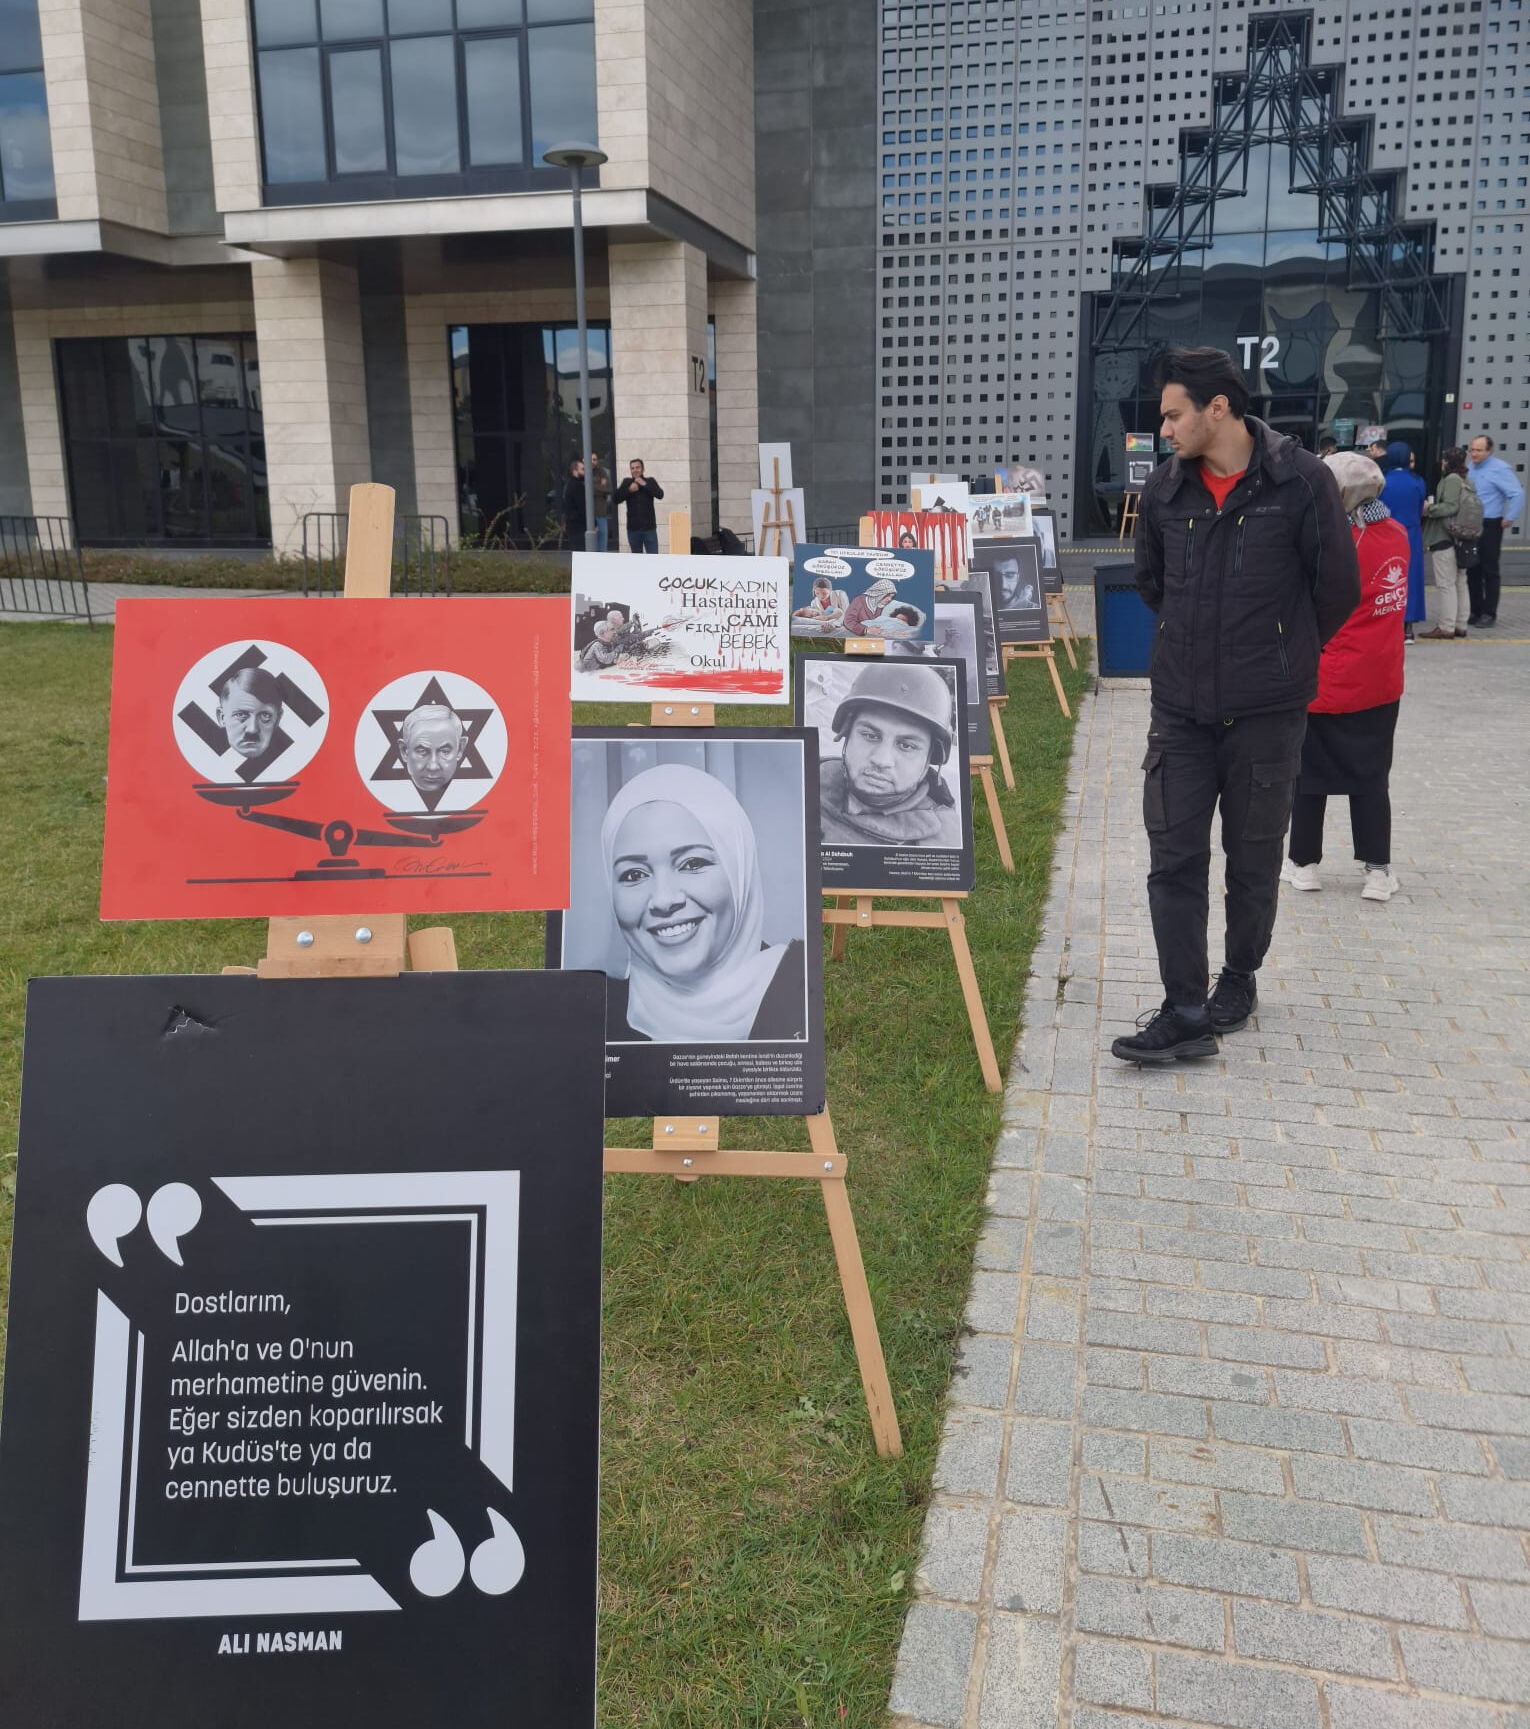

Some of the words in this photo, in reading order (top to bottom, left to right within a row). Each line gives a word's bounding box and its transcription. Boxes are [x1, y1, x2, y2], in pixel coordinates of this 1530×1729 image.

[1236, 335, 1280, 370] T2
[691, 355, 706, 394] T2
[659, 577, 718, 591] ÇOCUK
[720, 580, 778, 593] KADIN
[681, 592, 778, 609] Hastahane
[686, 623, 730, 634] FIRIN
[727, 612, 779, 628] CAMİ
[720, 633, 779, 650] BEBEK
[690, 654, 726, 668] Okul
[175, 1290, 291, 1315] Dostlarım,
[171, 1338, 249, 1362] Allah'a
[256, 1342, 283, 1361] ve
[289, 1337, 354, 1359] O'nun
[170, 1370, 324, 1396] merhametine
[331, 1367, 428, 1398] güvenin.
[169, 1406, 220, 1436] Eğer
[226, 1404, 302, 1429] sizden
[309, 1401, 443, 1431] koparılırsak
[167, 1445, 194, 1470] ya
[201, 1440, 301, 1465] Kudüs'te
[309, 1442, 336, 1466] ya
[343, 1437, 372, 1460] da
[165, 1475, 270, 1499] cennette
[276, 1472, 398, 1499] buluşuruz.
[217, 1632, 251, 1654] ALI
[256, 1630, 343, 1653] NASMAN
